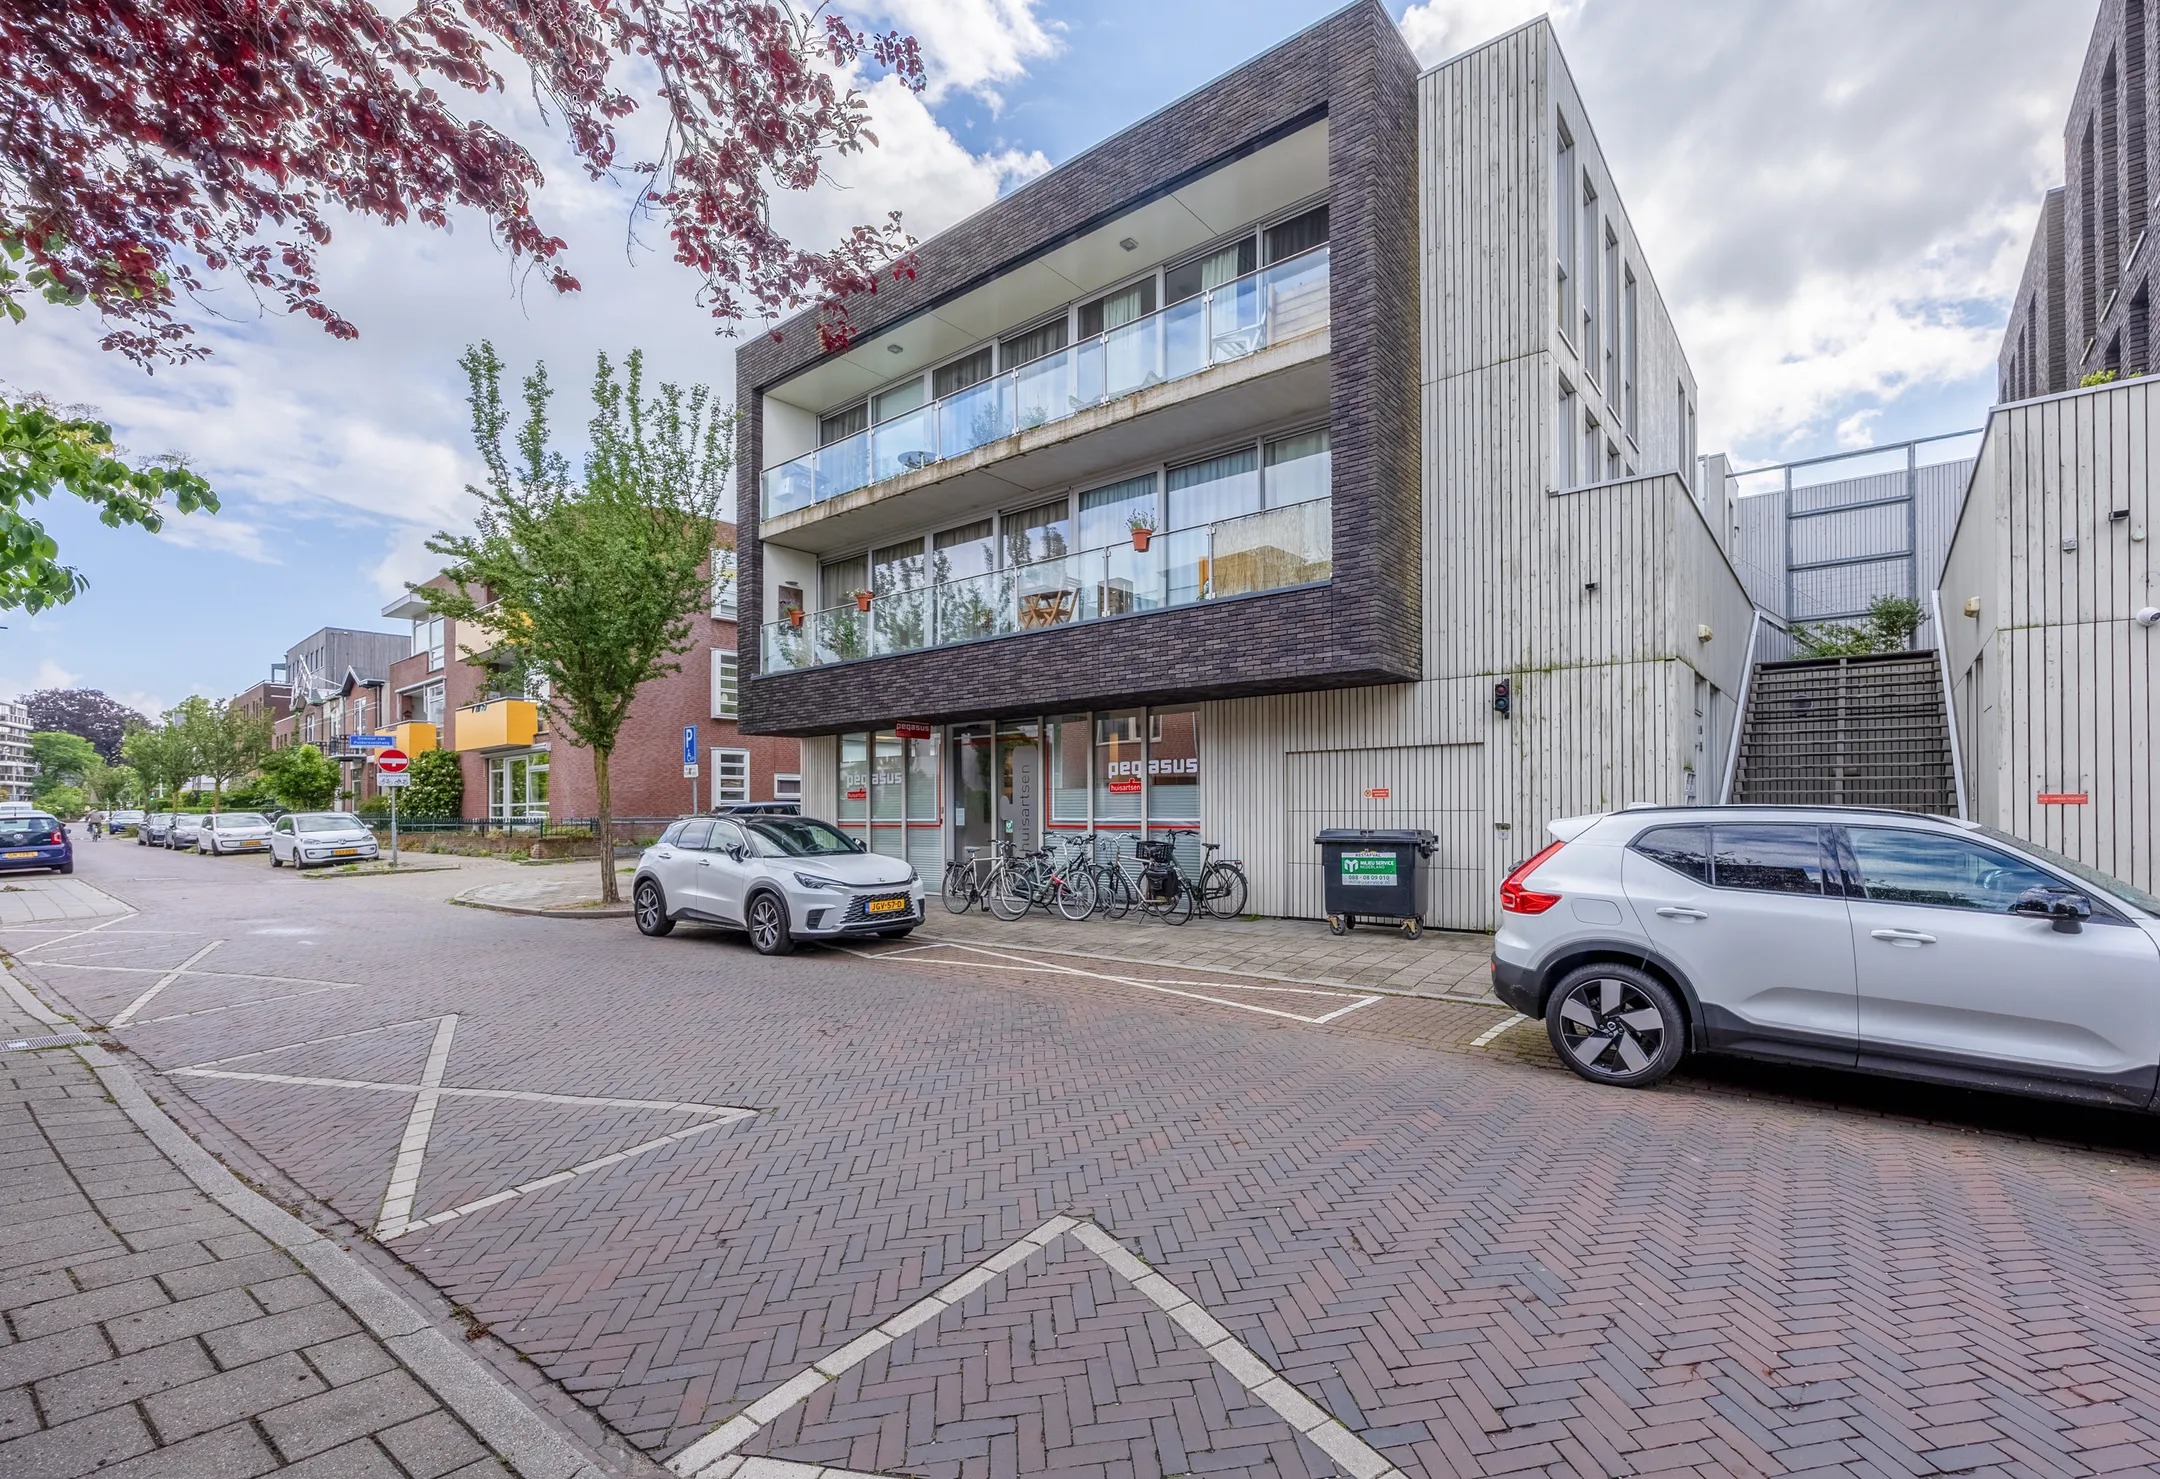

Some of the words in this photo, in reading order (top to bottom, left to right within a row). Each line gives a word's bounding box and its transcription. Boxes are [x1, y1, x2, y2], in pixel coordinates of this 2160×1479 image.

[896, 723, 930, 732] pegasus
[686, 729, 693, 748] P
[1110, 784, 1141, 792] huisartsen
[1019, 764, 1031, 852] huisartsen
[872, 901, 902, 911] JGV-57-D
